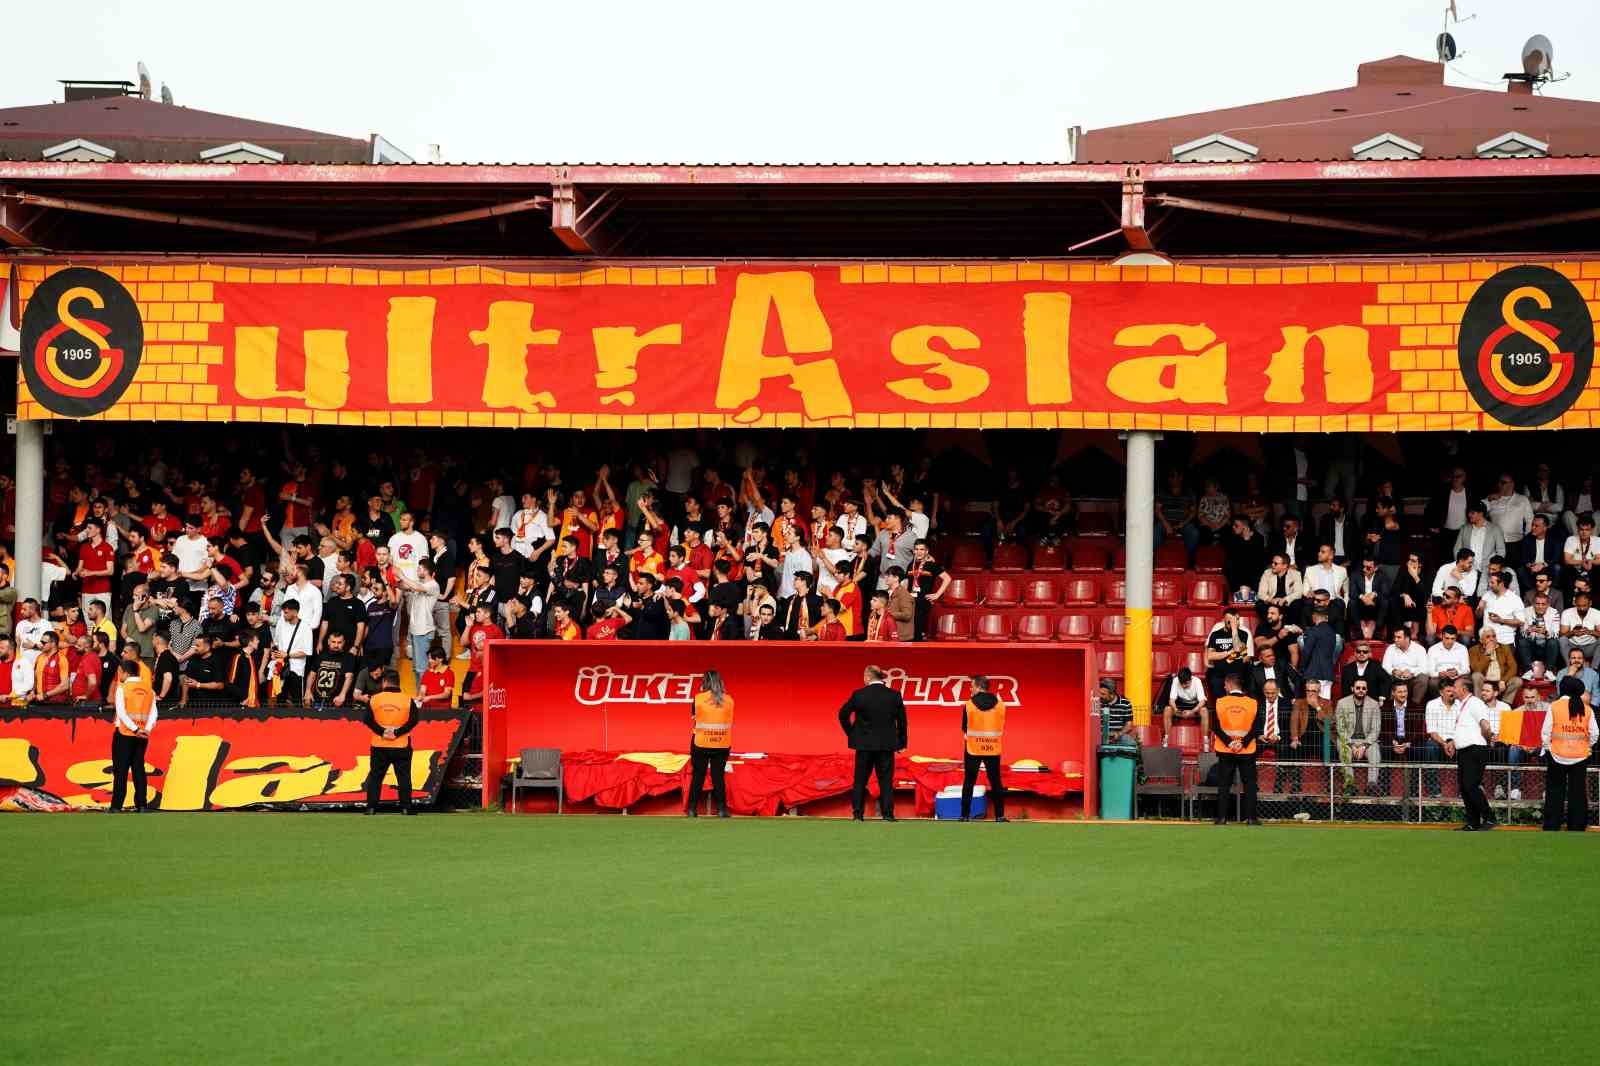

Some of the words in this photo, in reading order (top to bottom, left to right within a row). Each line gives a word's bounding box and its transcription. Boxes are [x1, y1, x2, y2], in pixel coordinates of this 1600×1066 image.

[62, 348, 92, 361] 1905
[234, 271, 1375, 424] ultrAslan
[1508, 352, 1542, 366] 1905
[318, 670, 336, 688] 23
